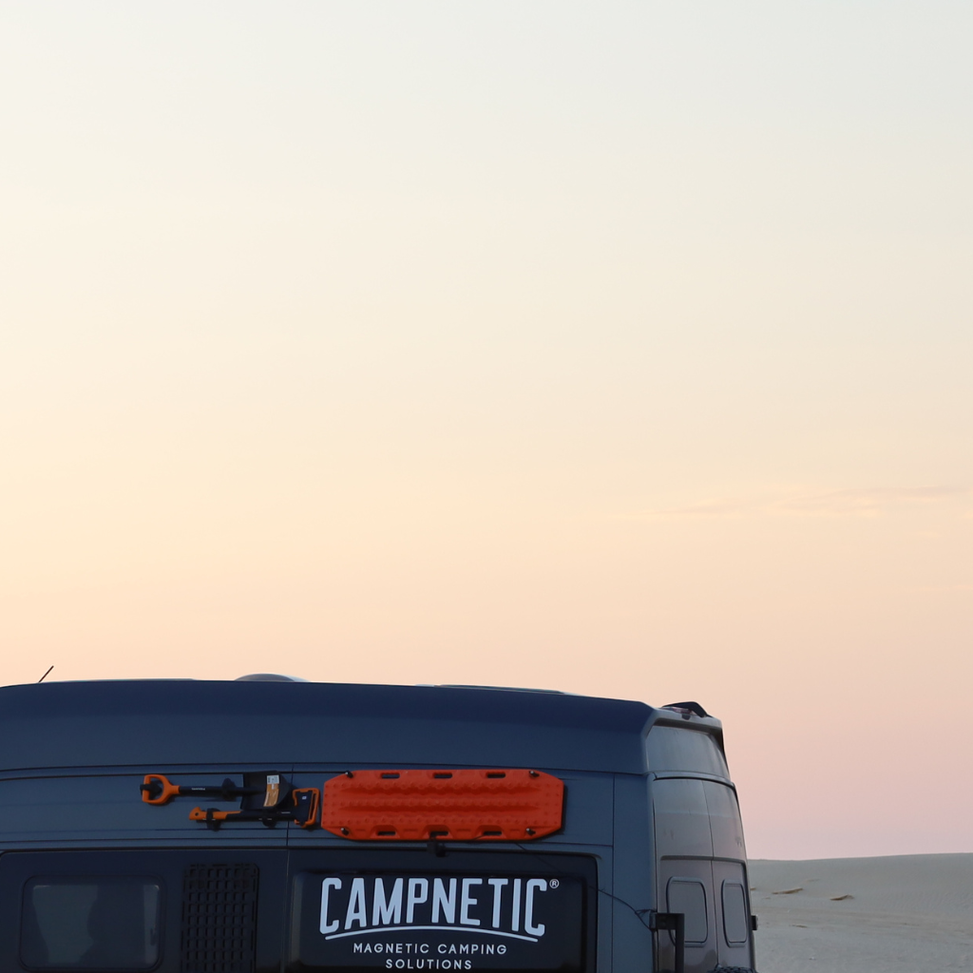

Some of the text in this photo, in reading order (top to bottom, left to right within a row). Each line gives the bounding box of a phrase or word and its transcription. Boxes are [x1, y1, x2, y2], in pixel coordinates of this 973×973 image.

[353, 942, 507, 955] MAGNETIC CAMPING
[385, 959, 472, 970] SOLUTIONS
